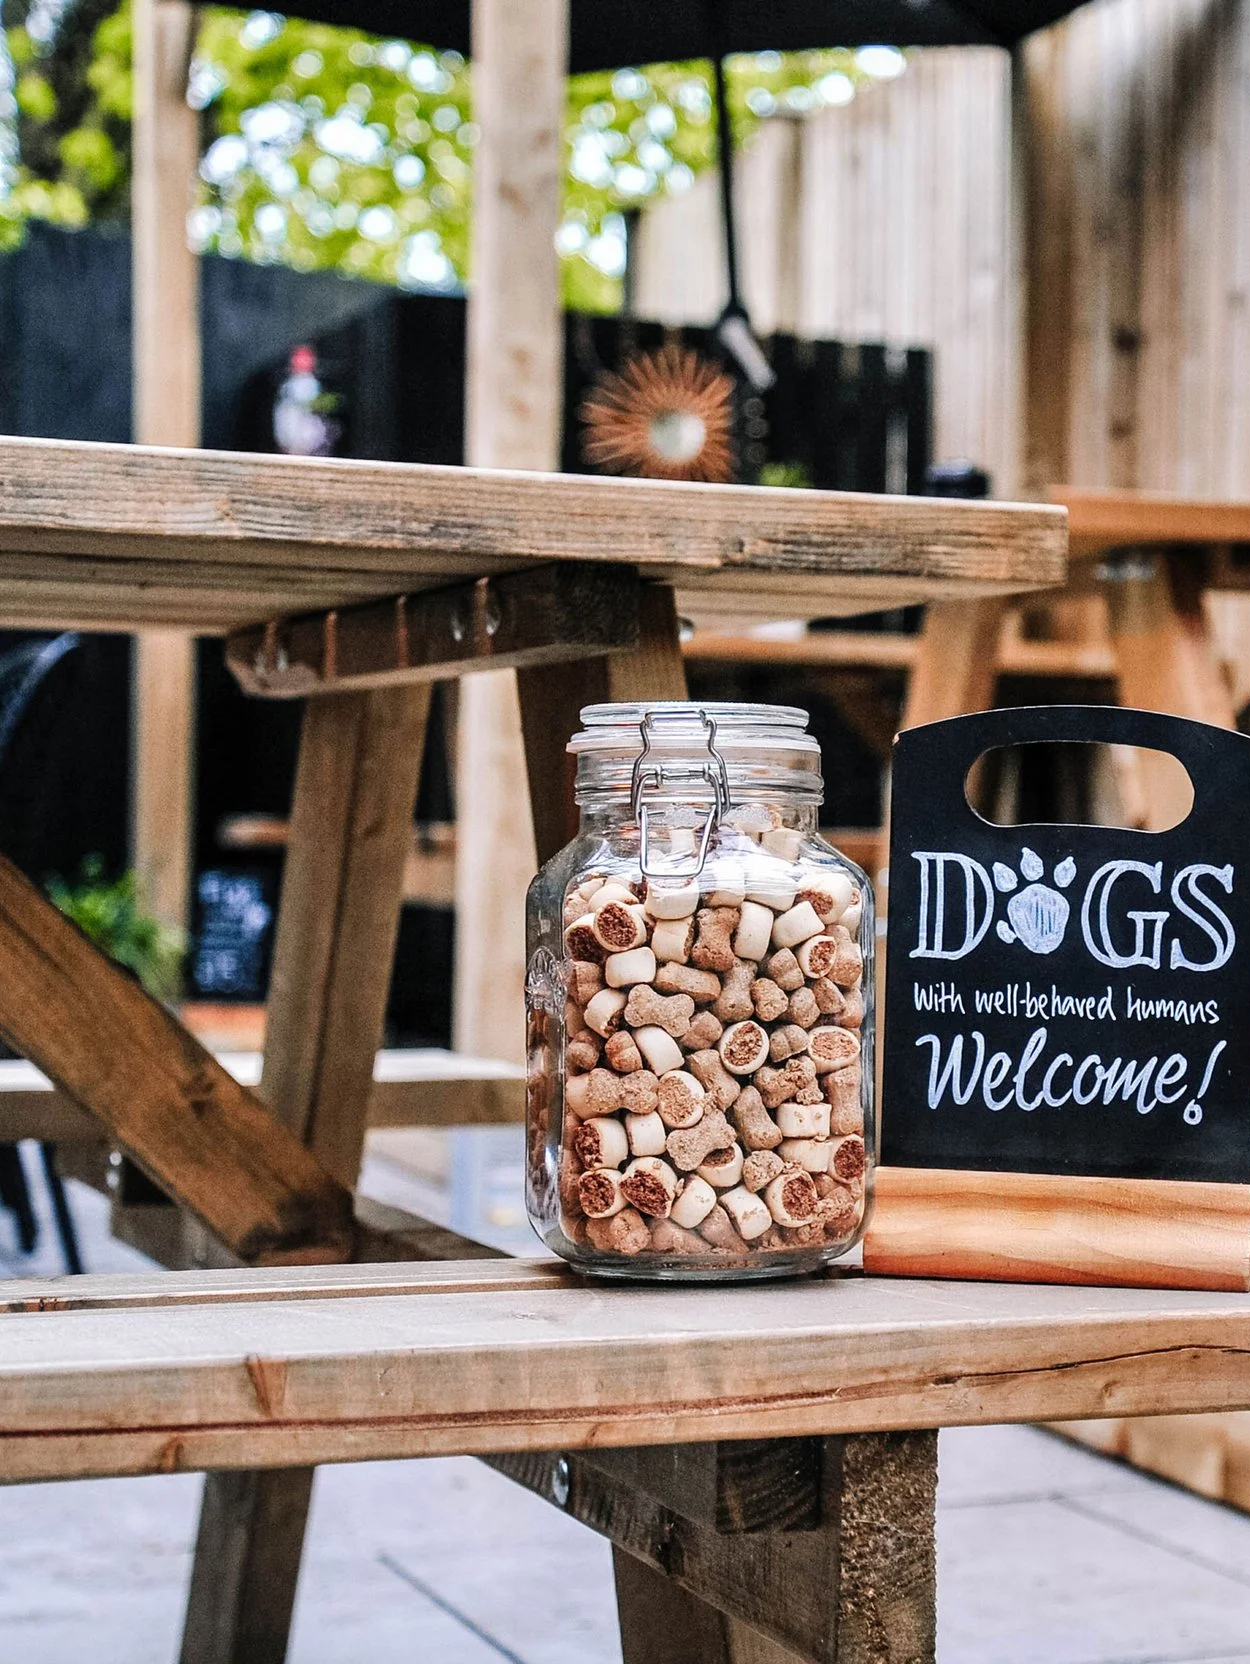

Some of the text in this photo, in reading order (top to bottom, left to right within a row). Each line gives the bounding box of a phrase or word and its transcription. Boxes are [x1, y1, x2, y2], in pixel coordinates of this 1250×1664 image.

[975, 984, 1114, 1021] well-behaved
[1126, 986, 1220, 1025] humans
[914, 1027, 1228, 1126] Welcome!
